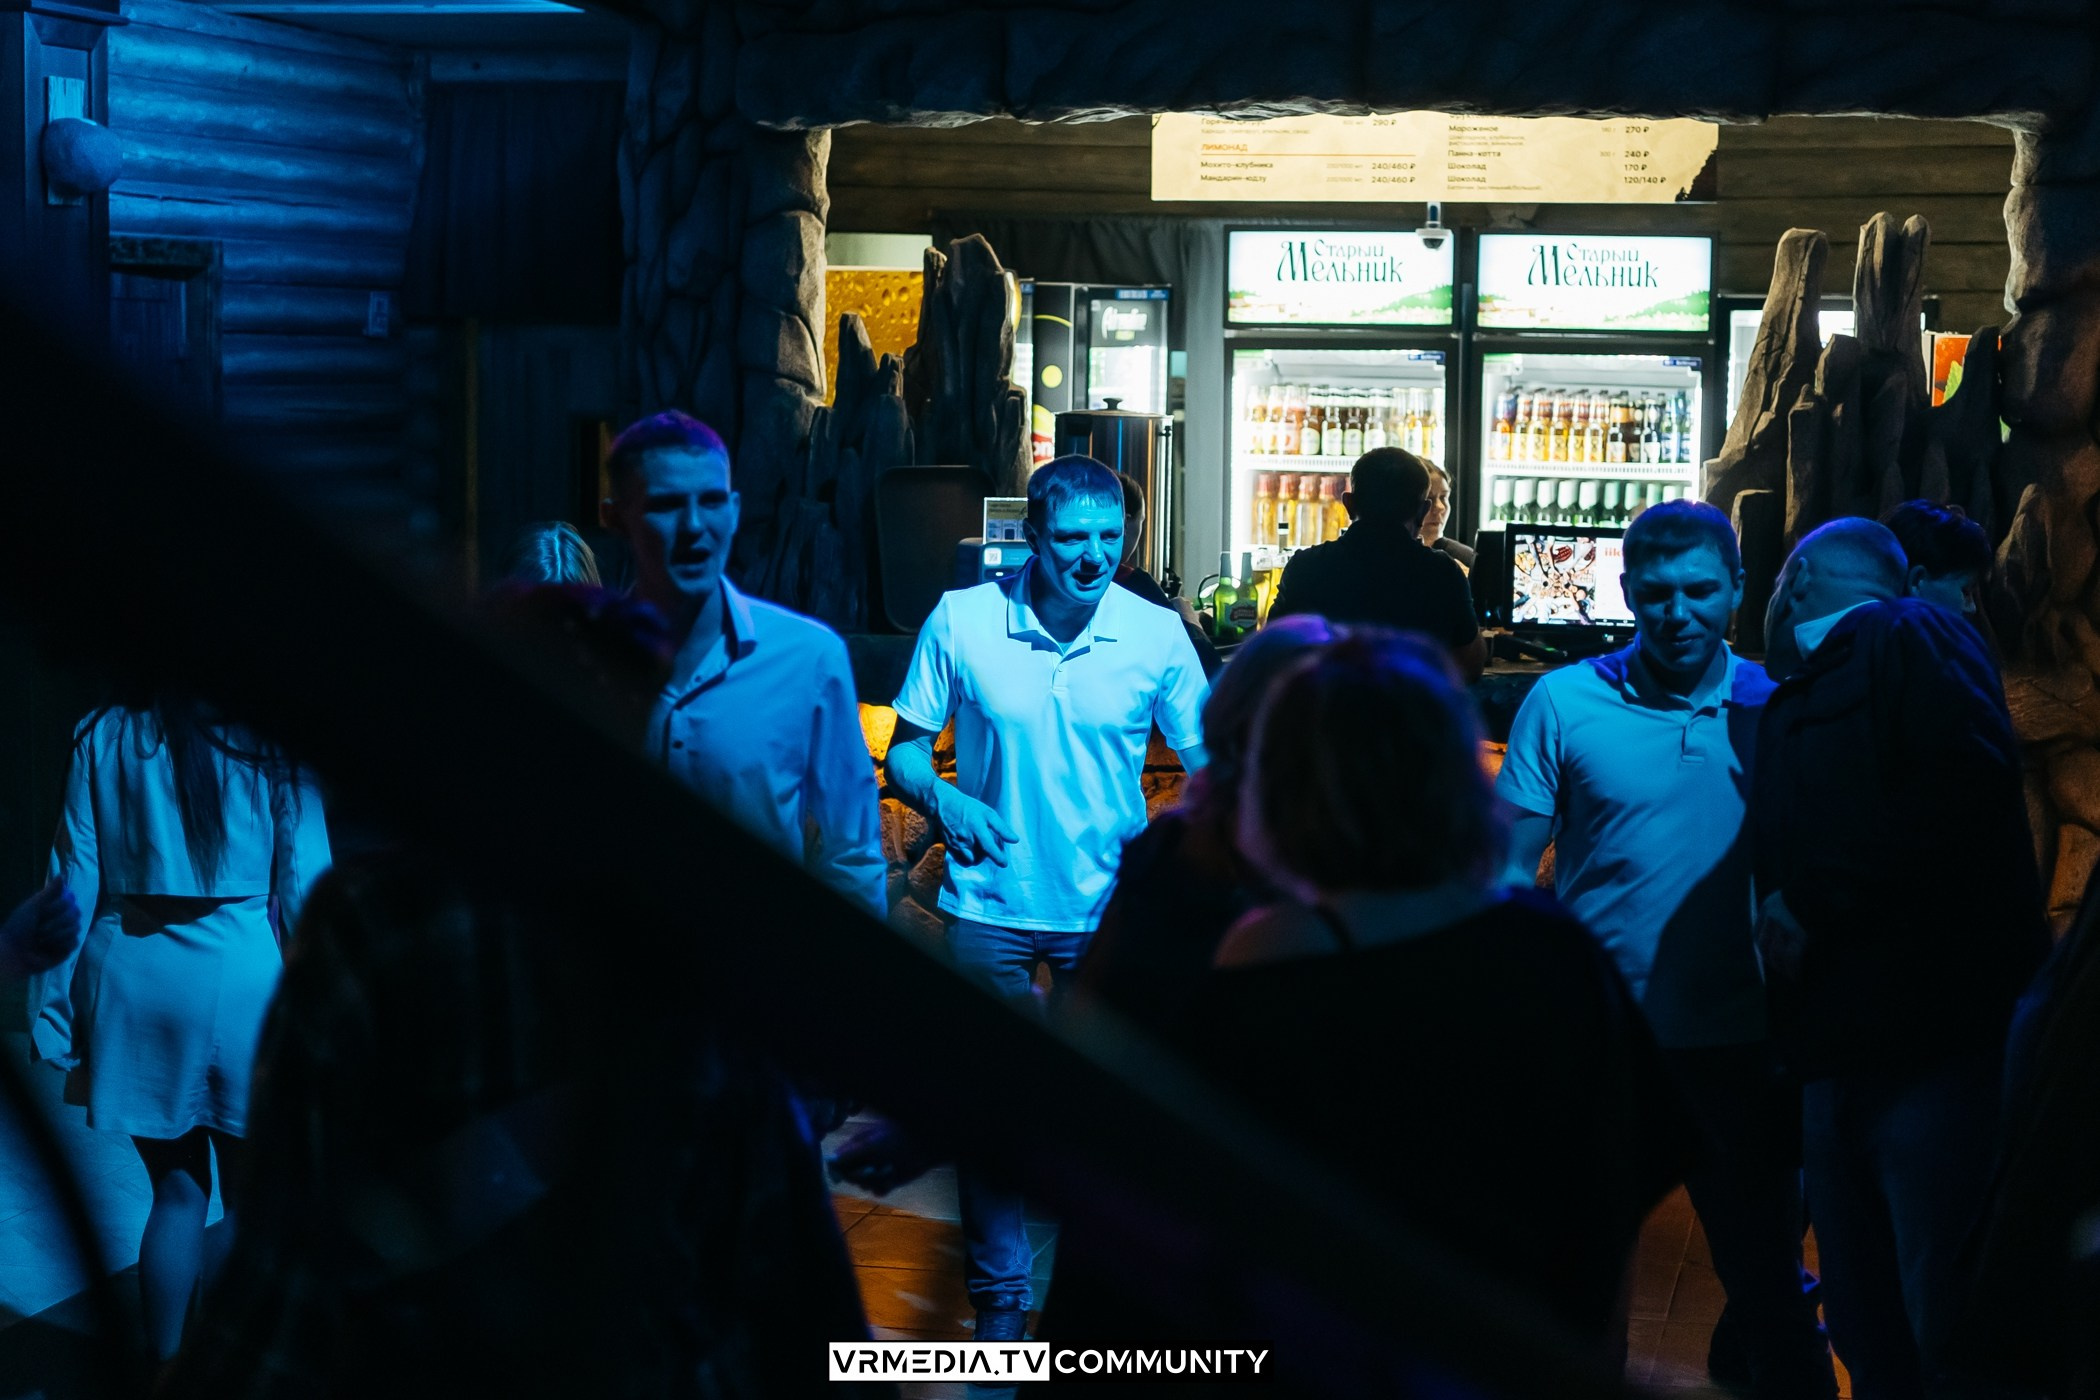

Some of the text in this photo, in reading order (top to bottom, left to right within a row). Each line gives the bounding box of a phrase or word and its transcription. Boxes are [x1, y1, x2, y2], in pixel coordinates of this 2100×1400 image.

[1448, 125, 1499, 133] Мороженое
[1625, 126, 1641, 134] 270
[1201, 143, 1248, 152] ЛИМОНАД
[1624, 150, 1641, 158] 240
[1200, 161, 1274, 169] Мохито-клубника
[1447, 162, 1487, 170] Шоколад
[1371, 176, 1408, 184] 240/460
[1447, 175, 1487, 183] Шоколад
[1624, 176, 1658, 184] 120/140
[1277, 240, 1403, 282] Мельник
[1528, 245, 1658, 287] Мельник
